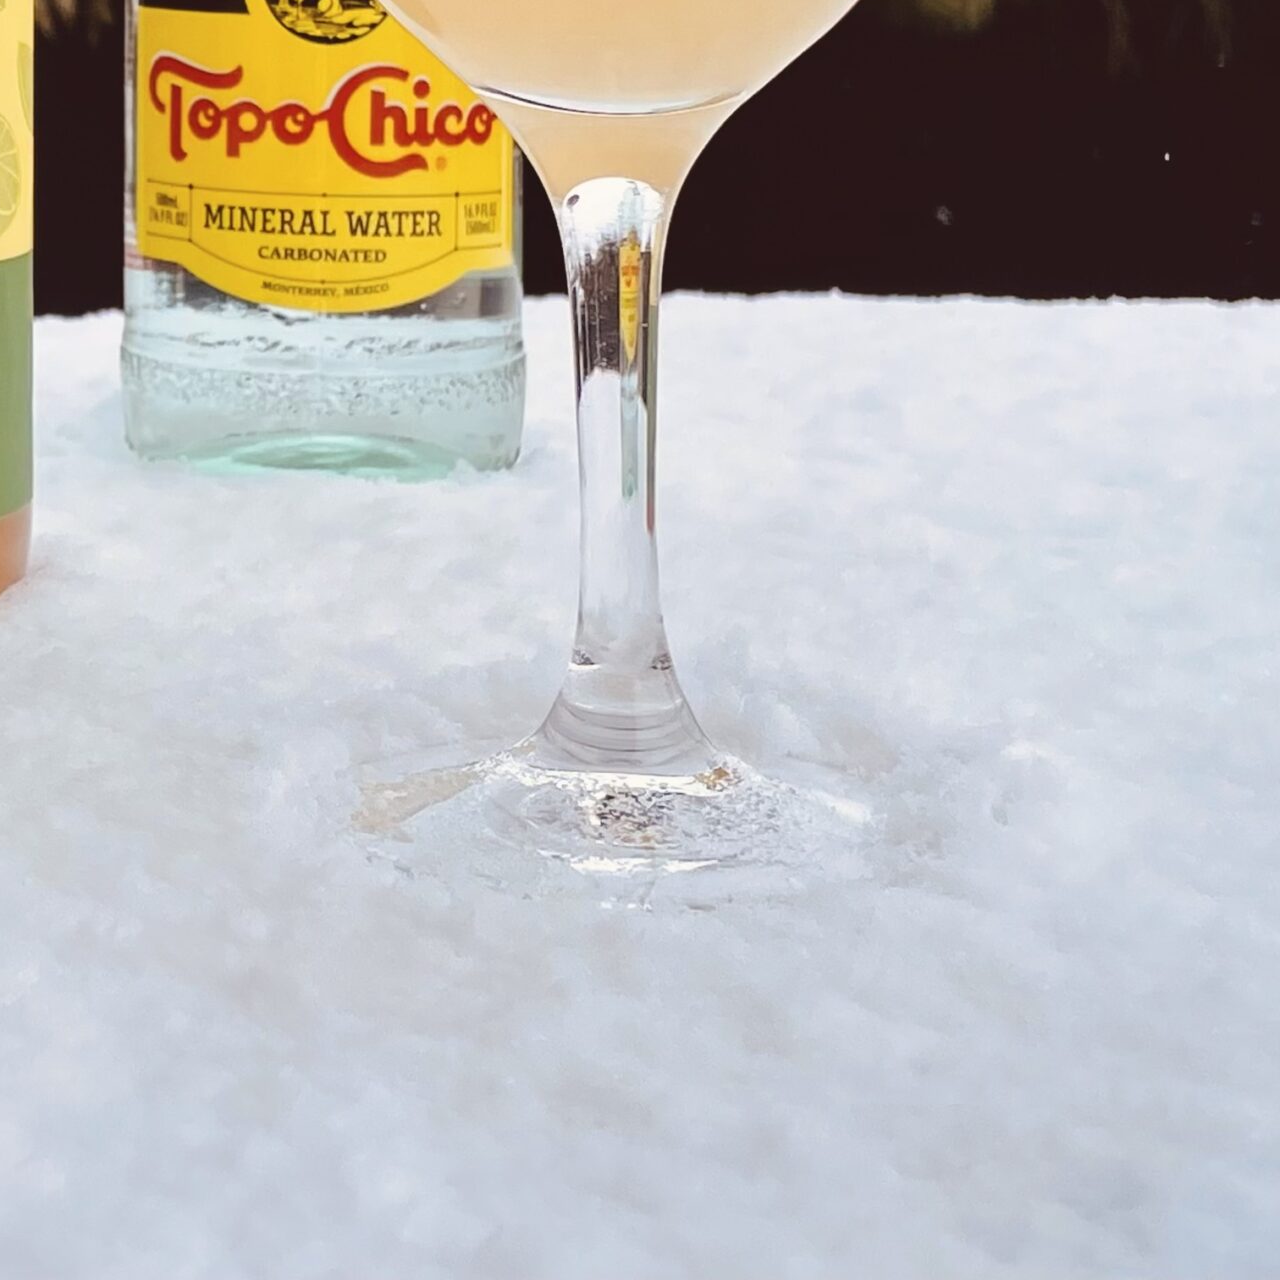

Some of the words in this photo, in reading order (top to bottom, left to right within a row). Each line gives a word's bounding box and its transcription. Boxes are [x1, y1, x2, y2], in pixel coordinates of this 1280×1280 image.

[149, 54, 320, 162] Topo
[326, 65, 498, 179] Chico
[203, 202, 337, 238] MINERAL
[345, 208, 443, 238] WATER
[257, 245, 388, 264] CARBONATED
